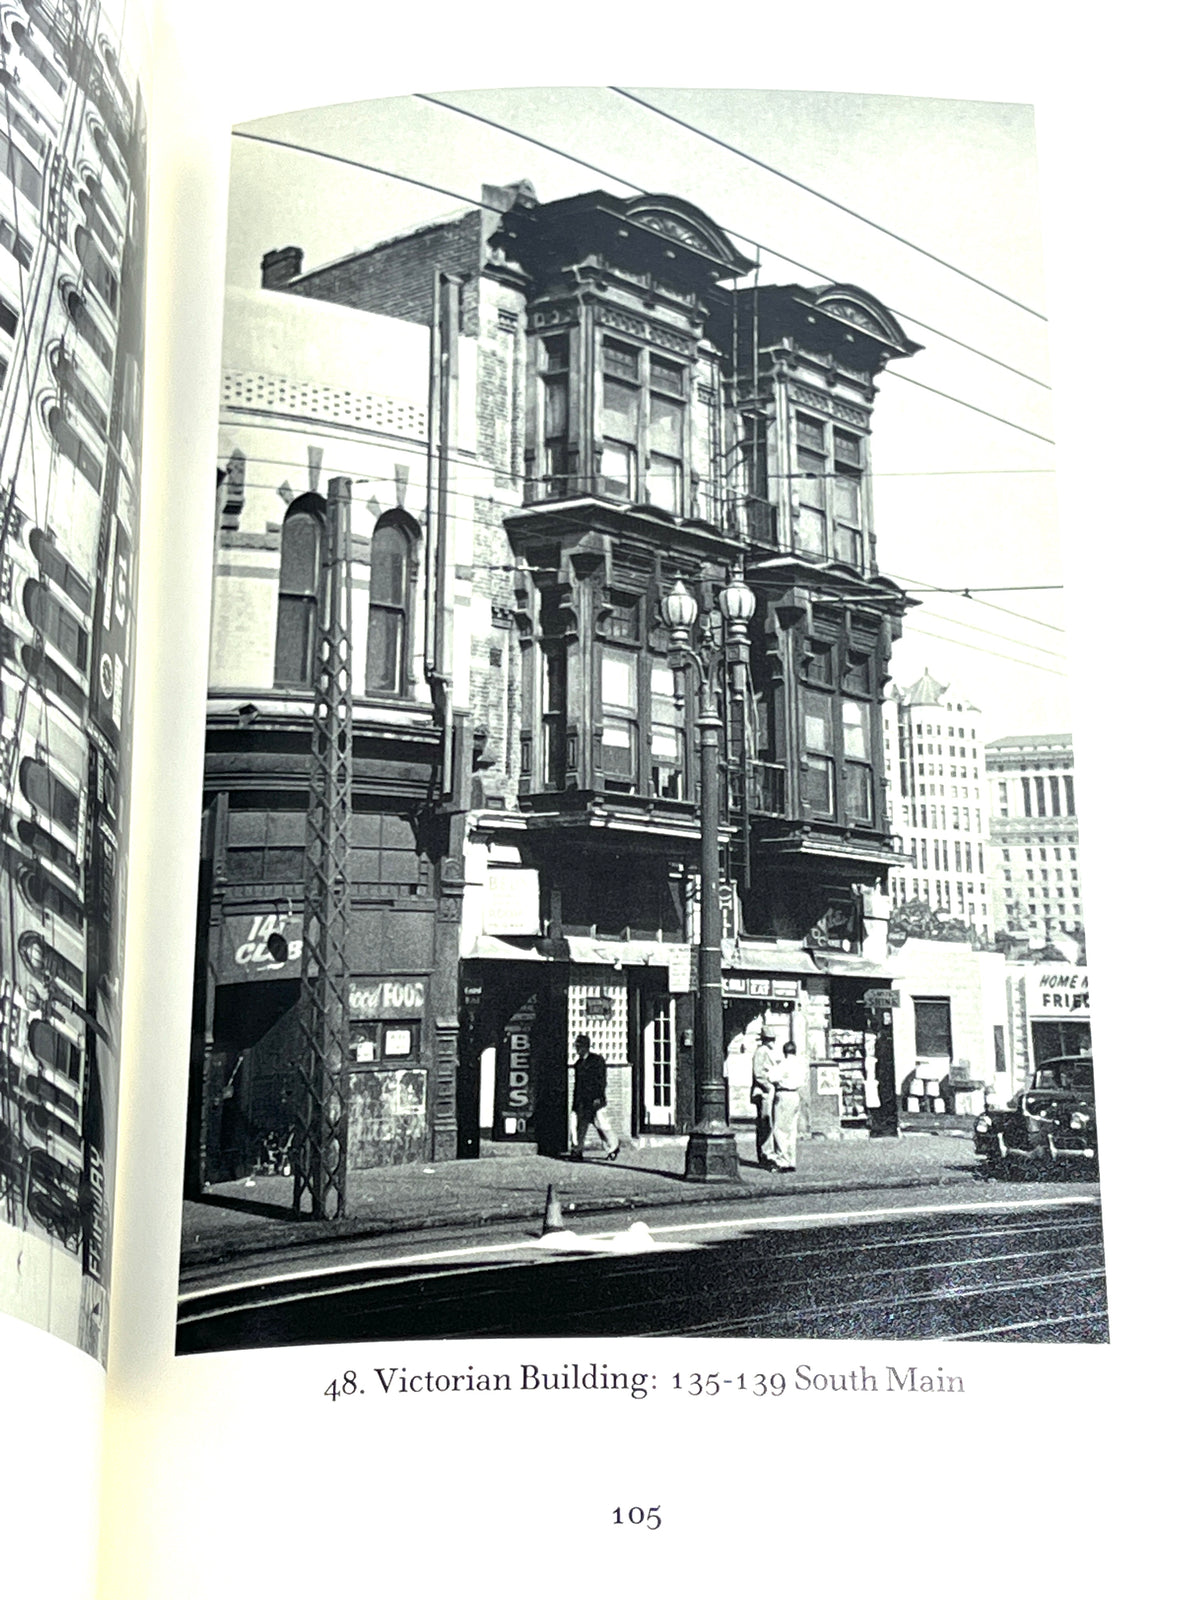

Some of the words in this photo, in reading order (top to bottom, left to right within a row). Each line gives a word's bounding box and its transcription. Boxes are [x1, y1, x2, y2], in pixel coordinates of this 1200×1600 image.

[235, 940, 303, 964] CLB
[1040, 974, 1078, 988] HOME
[507, 1033, 531, 1108] BEDS
[324, 1370, 365, 1402] 48.
[373, 1365, 511, 1393] Victorian
[520, 1363, 656, 1399] Building:
[673, 1372, 786, 1396] 135-139
[795, 1365, 878, 1391] South
[886, 1366, 965, 1392] Main
[613, 1505, 661, 1530] 105
